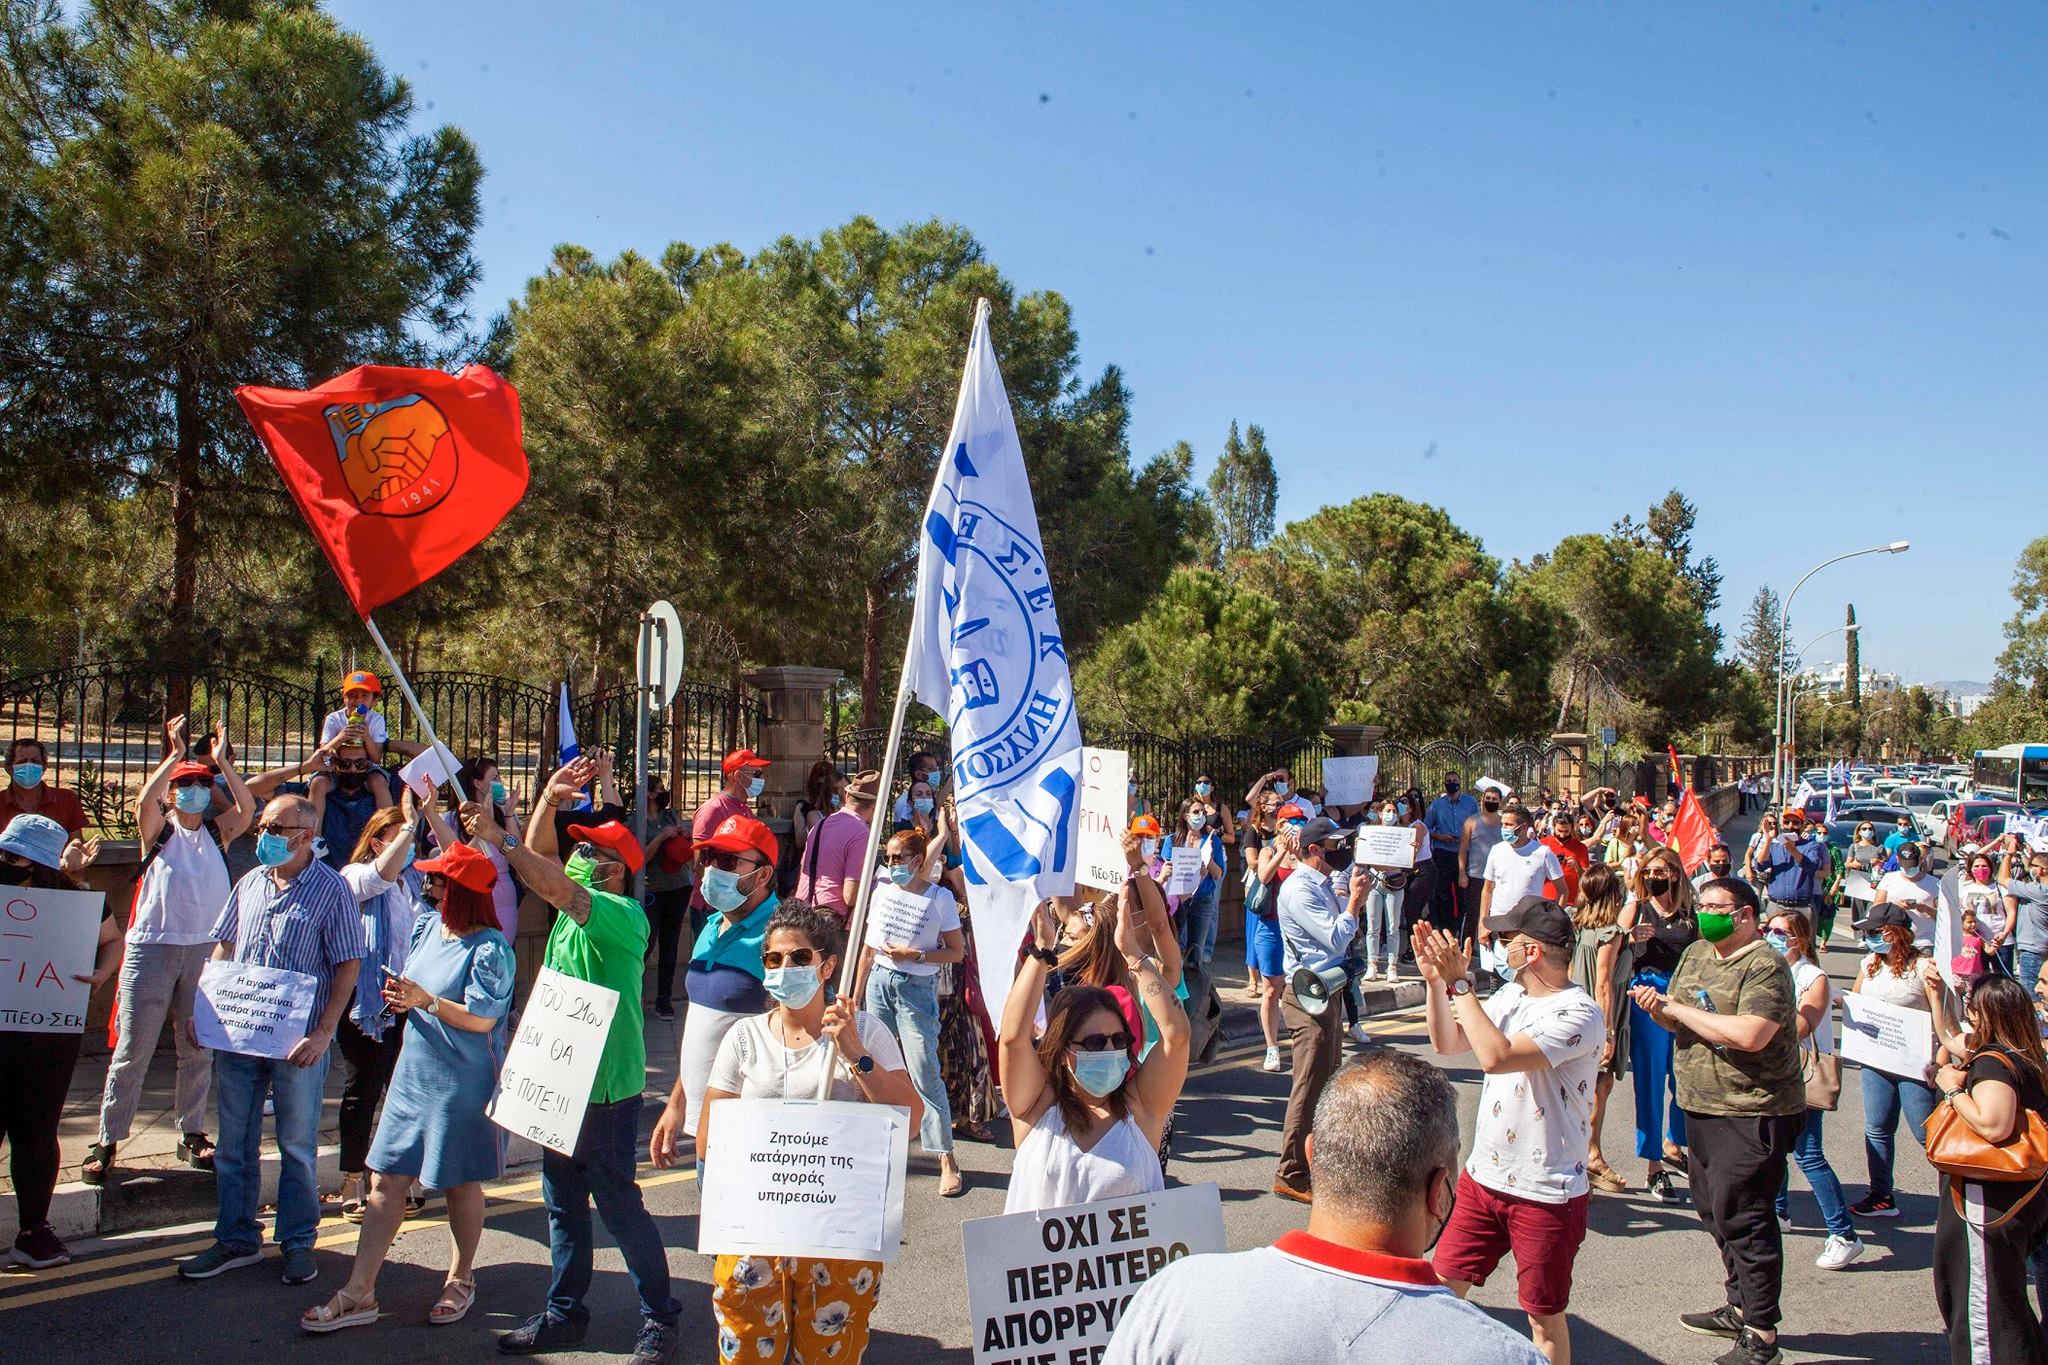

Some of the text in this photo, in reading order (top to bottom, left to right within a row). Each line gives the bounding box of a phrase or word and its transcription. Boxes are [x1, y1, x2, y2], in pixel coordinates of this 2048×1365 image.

[400, 478, 440, 509] 1941
[237, 976, 277, 991] Η αγορά
[216, 988, 294, 1008] υπηρεσιών είναι
[0, 1009, 84, 1027] ΠΕΟ-ΣΕΚ
[215, 1002, 287, 1022] κατάρα για την
[217, 1017, 275, 1035] εκπαίδευση
[519, 1024, 574, 1065] ΔΕΝ ΘΑ
[769, 1131, 830, 1148] Ζητούμε
[750, 1151, 854, 1169] κατάργηση της
[772, 1170, 825, 1186] αγοράς
[758, 1190, 837, 1205] υπηρεσιών
[1042, 1204, 1150, 1253] ΟΧΙ ΣΕ
